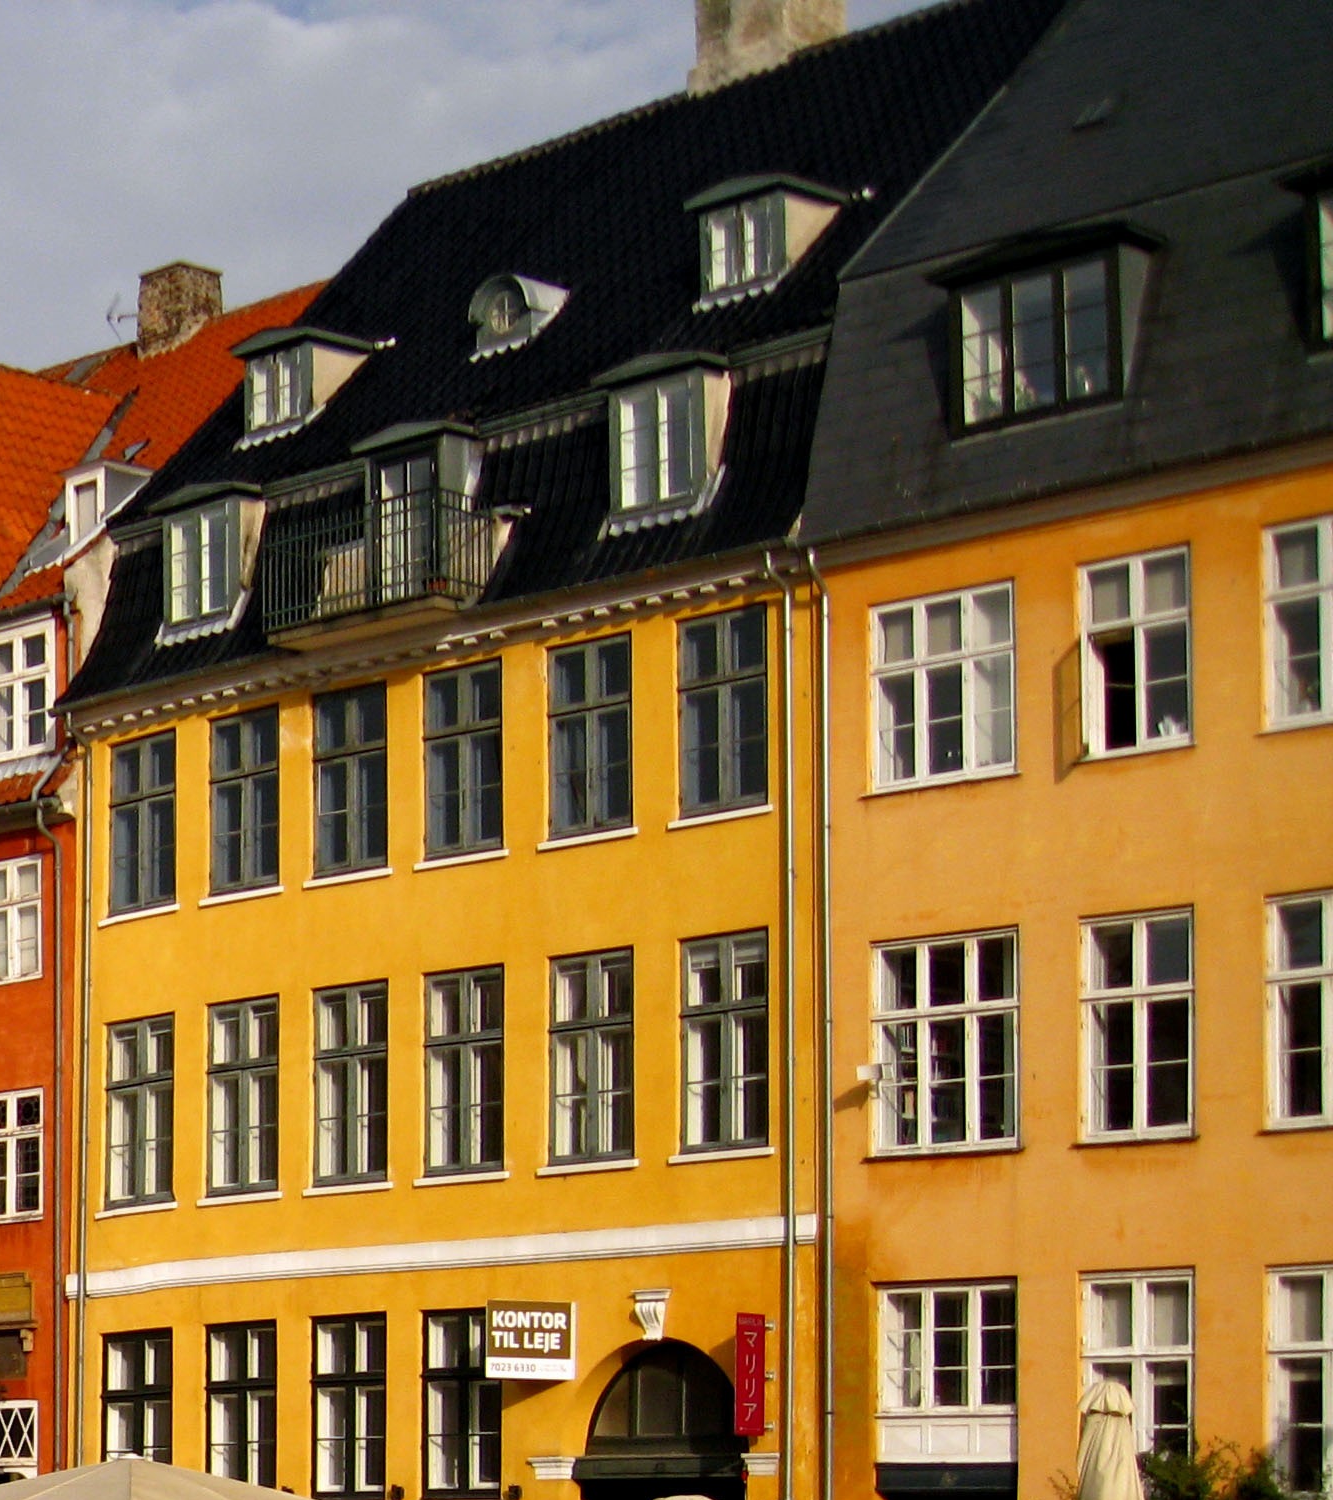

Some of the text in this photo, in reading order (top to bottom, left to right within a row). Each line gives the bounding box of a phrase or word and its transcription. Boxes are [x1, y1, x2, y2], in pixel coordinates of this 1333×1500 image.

[492, 1310, 567, 1329] KONTOR
[491, 1331, 561, 1354] TIL LEJE
[491, 1363, 512, 1372] 7023
[514, 1363, 536, 1373] 6330
[743, 1331, 758, 1421] マリリア
